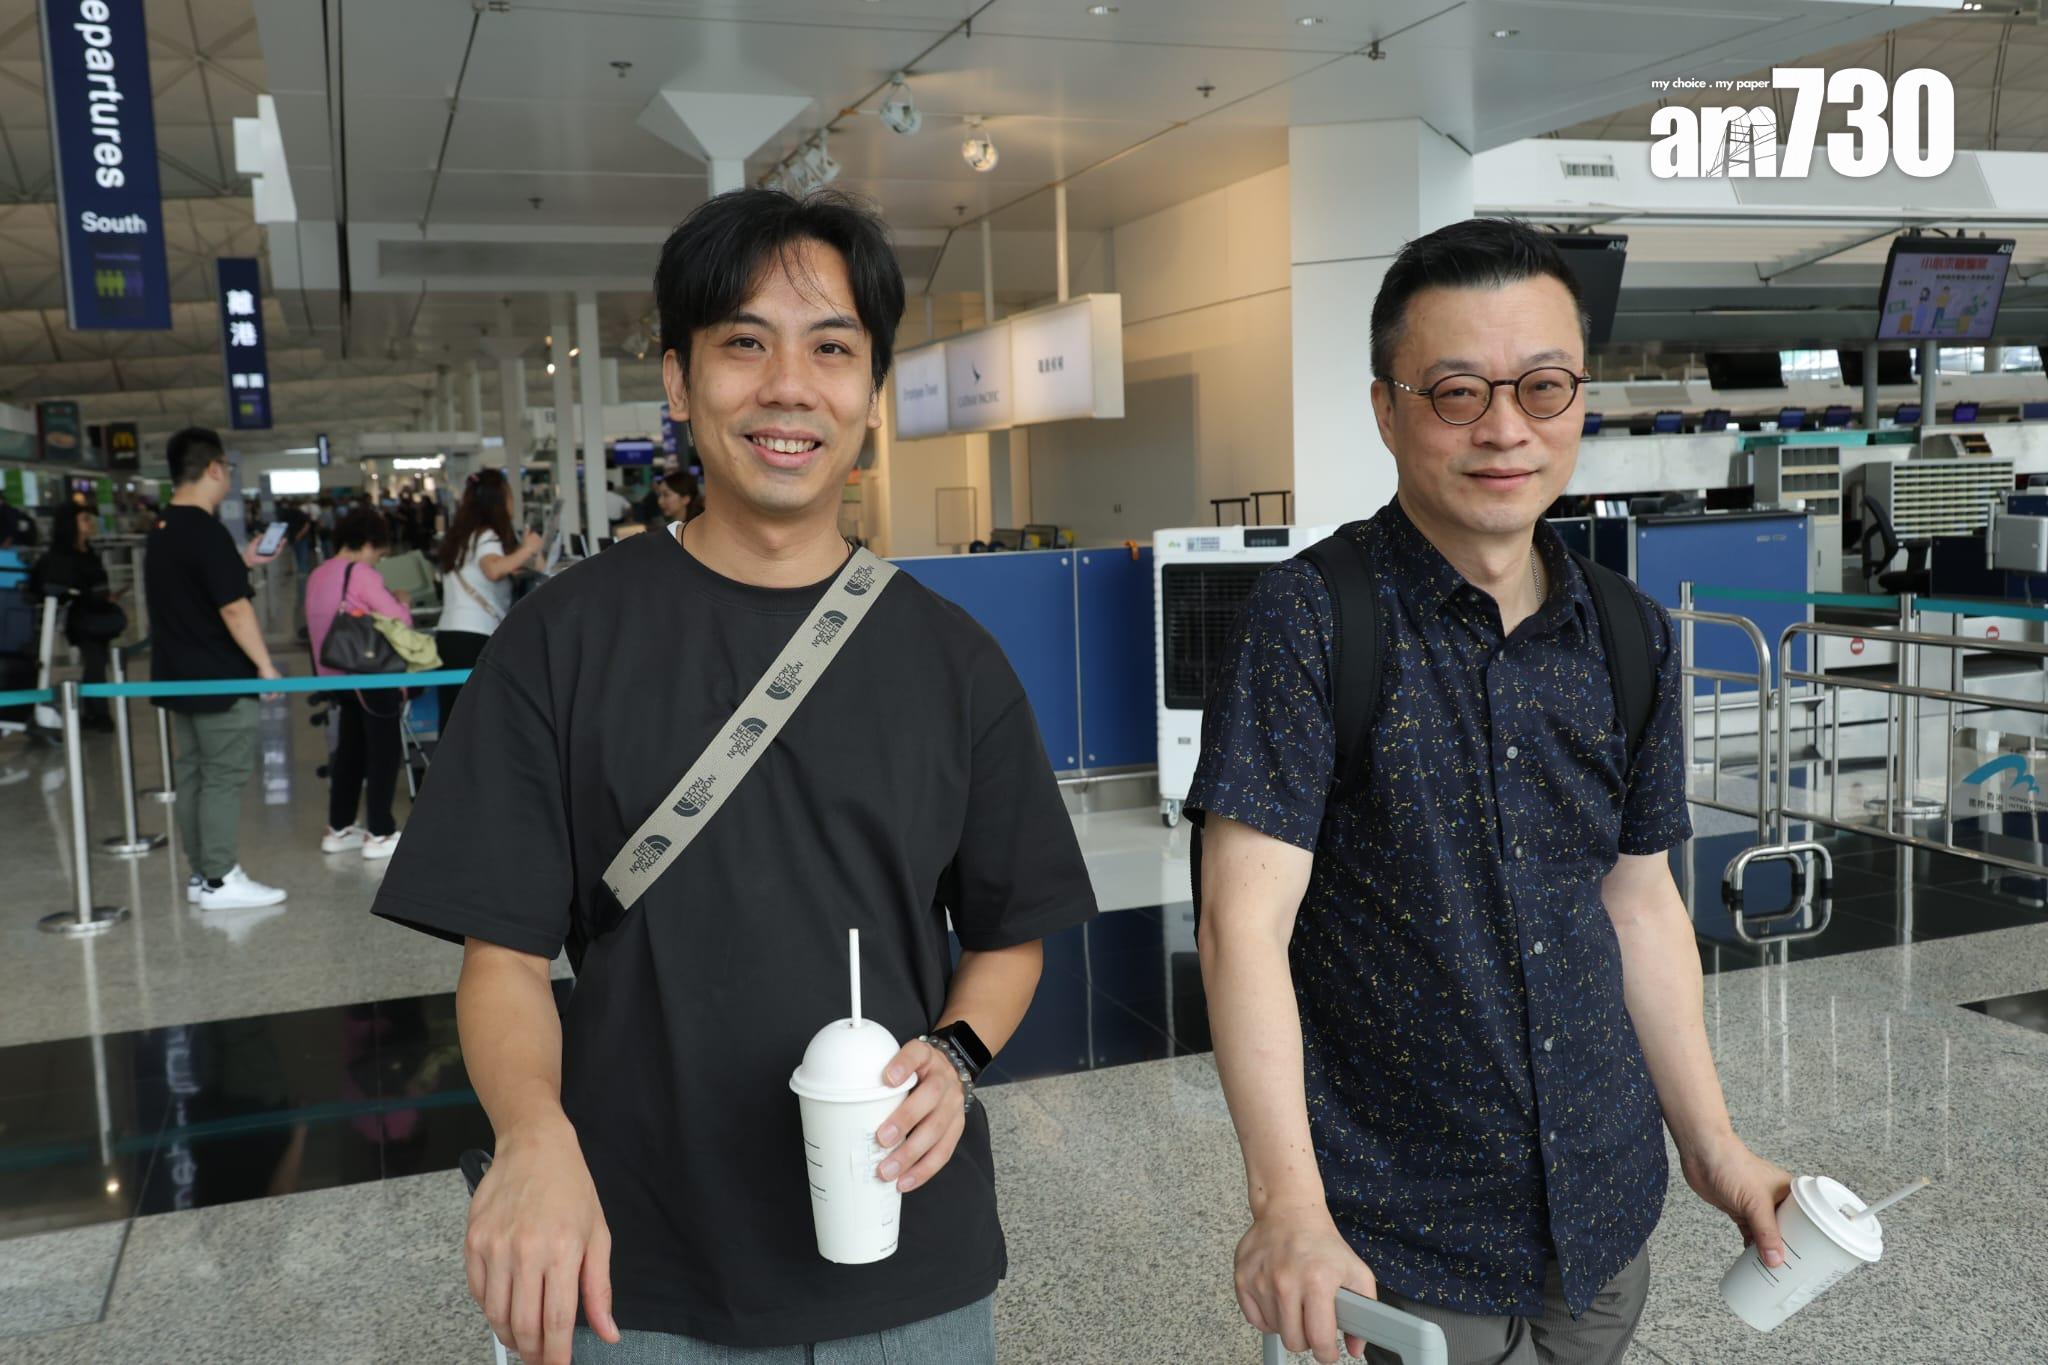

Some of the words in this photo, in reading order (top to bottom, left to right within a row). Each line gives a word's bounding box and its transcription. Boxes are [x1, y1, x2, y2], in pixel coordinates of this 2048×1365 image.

[73, 0, 125, 188] epartures
[81, 211, 148, 234] South
[811, 620, 832, 648] NORTH
[812, 616, 826, 631] THE
[823, 625, 840, 645] FACE
[773, 663, 792, 686] FACE
[781, 661, 803, 690] NORTH
[788, 678, 802, 694] THE
[727, 728, 751, 759] NORTH
[729, 724, 745, 741] THE
[739, 735, 758, 757] FACE
[684, 777, 703, 799] FACE
[690, 774, 716, 804] NORTH
[697, 793, 714, 810] THE
[629, 846, 654, 874] NORTH
[632, 841, 647, 857] THE
[640, 852, 661, 873] FACE
